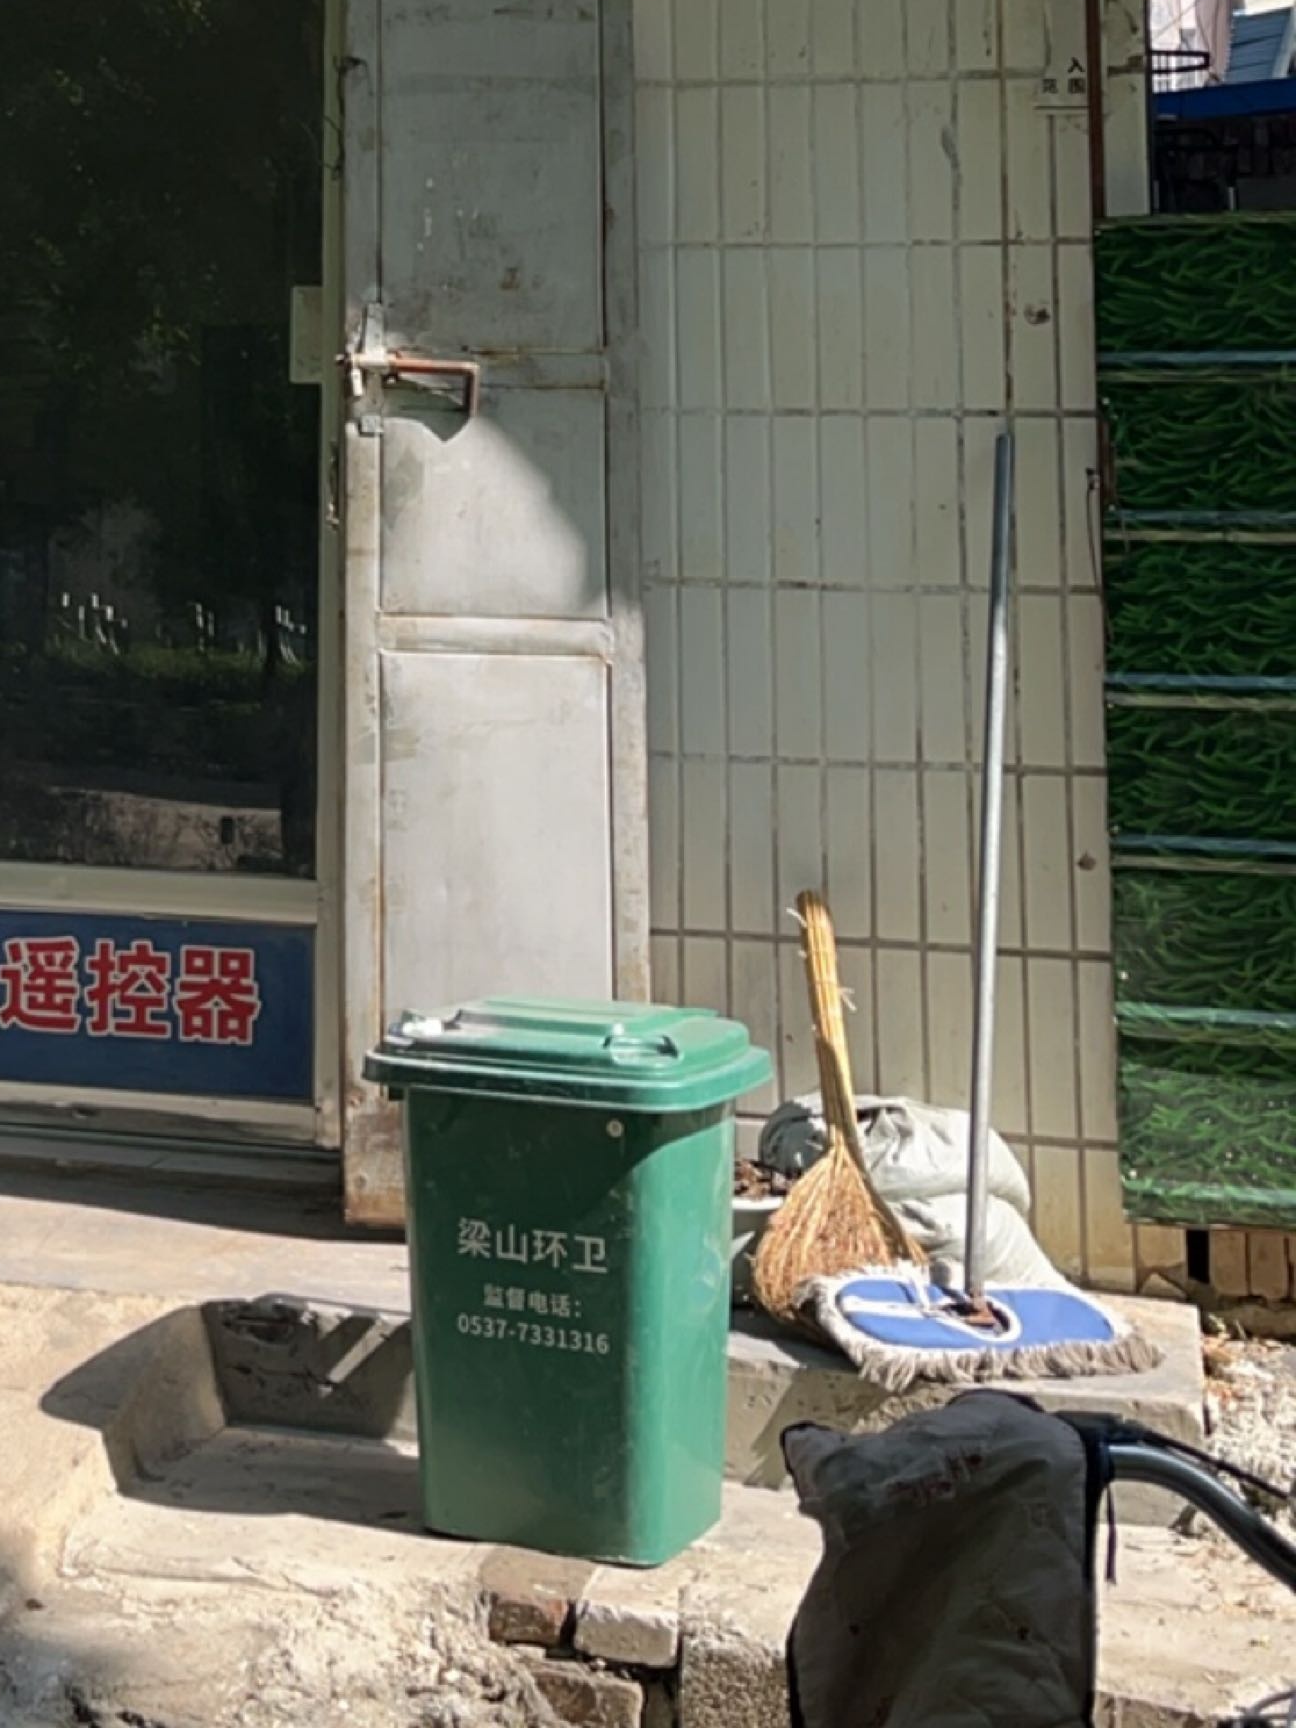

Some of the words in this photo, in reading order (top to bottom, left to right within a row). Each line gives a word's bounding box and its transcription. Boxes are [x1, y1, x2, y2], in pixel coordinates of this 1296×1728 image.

[457, 1217, 608, 1274] 梁山环卫
[457, 1313, 610, 1355] 0537-7331316
